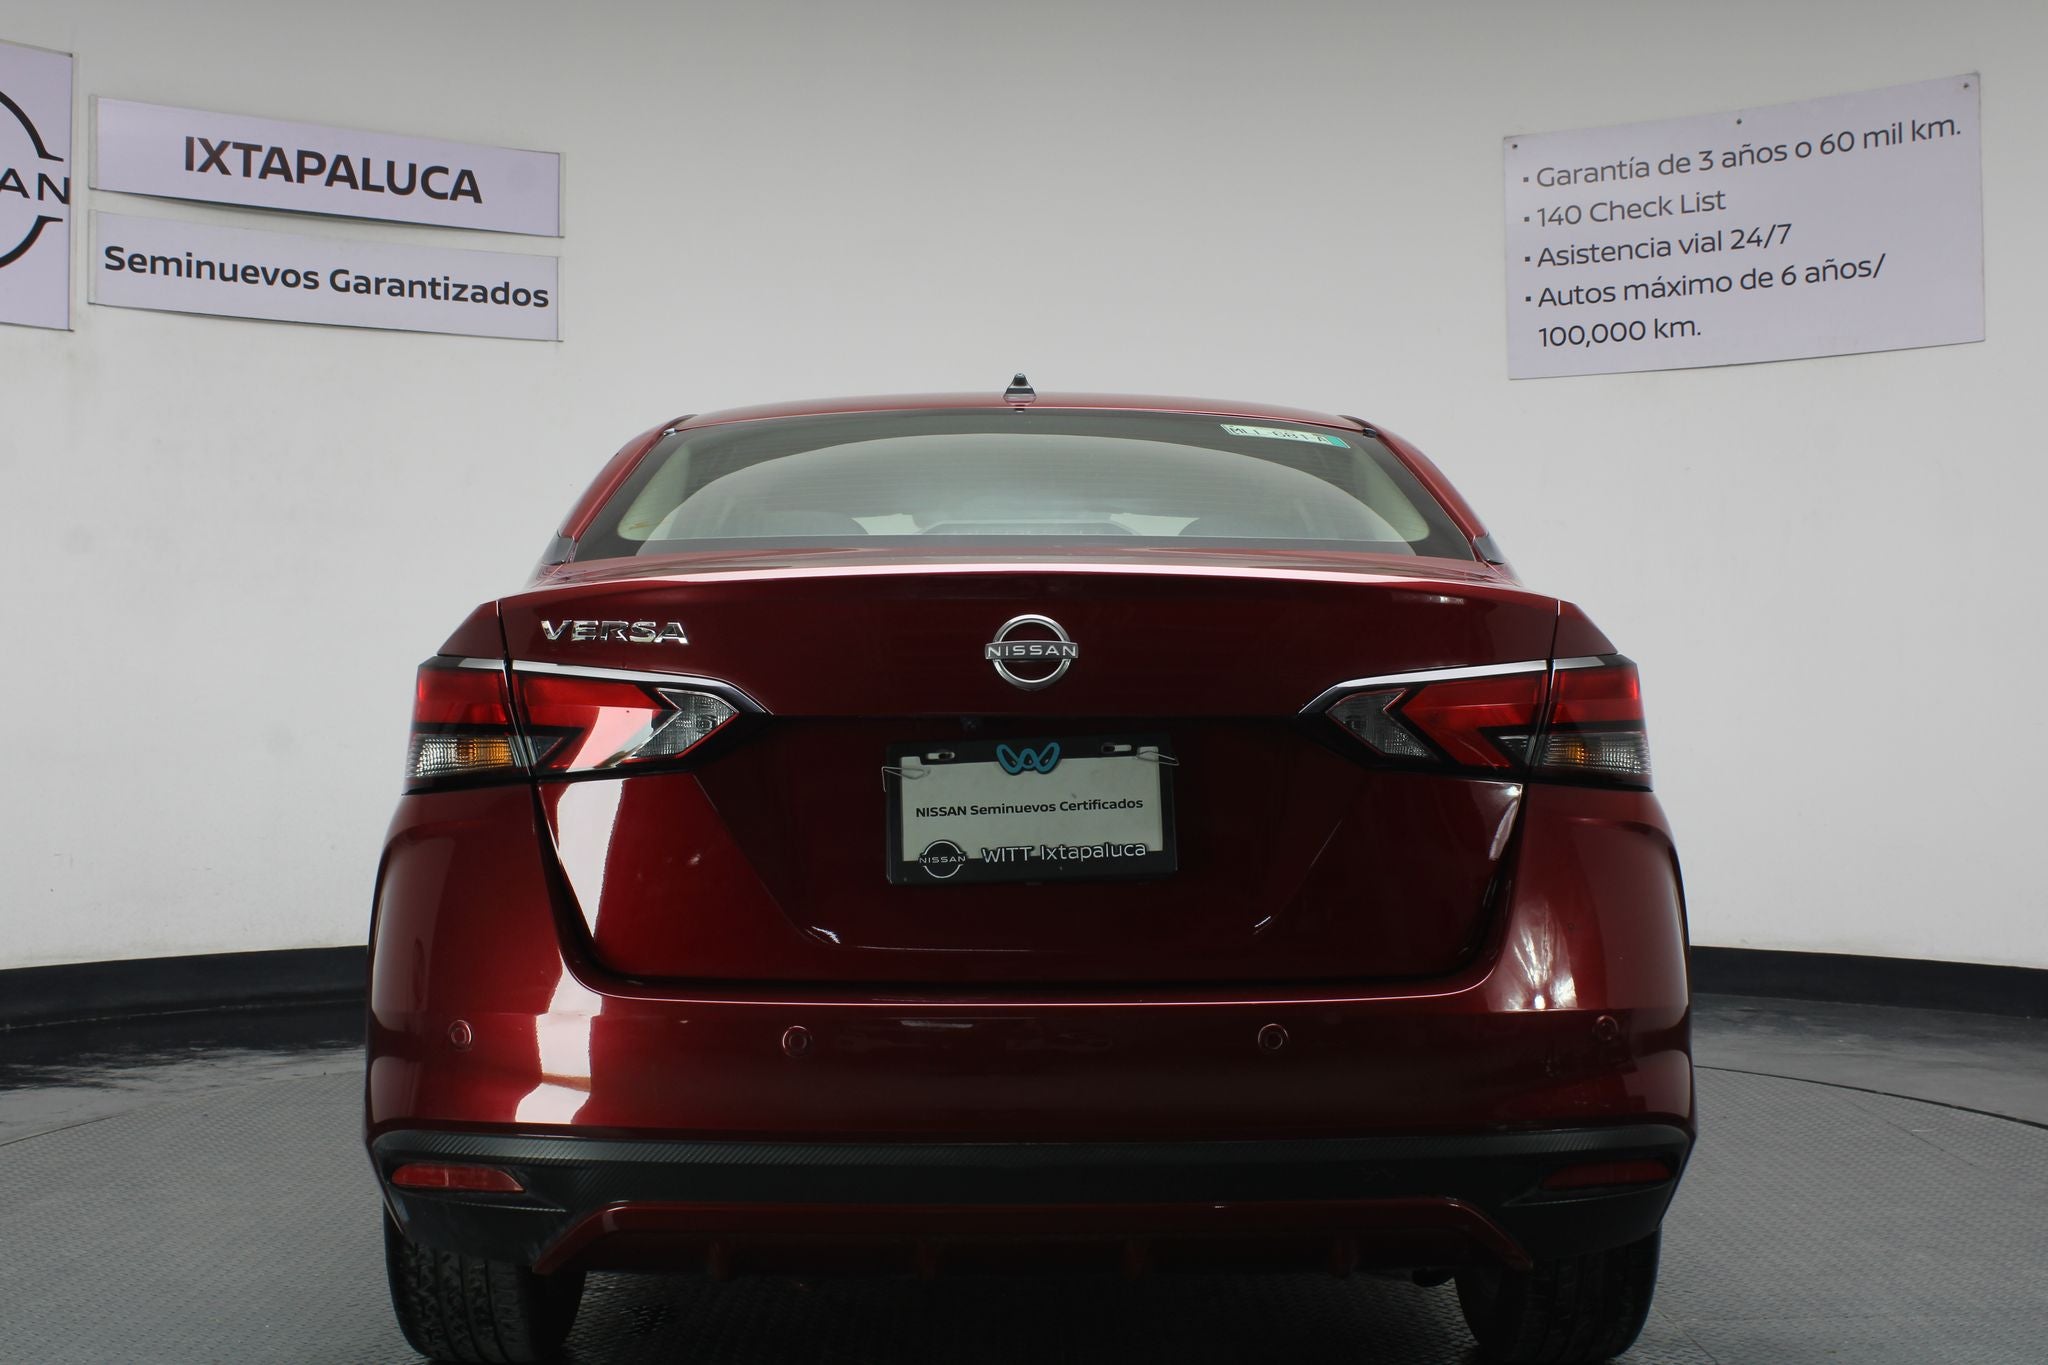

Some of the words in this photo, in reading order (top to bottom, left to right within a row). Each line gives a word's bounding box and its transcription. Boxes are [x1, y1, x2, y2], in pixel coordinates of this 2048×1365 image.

[1537, 156, 1650, 187] Garantía
[1658, 151, 1691, 175] de
[1699, 150, 1713, 171] 3
[1721, 141, 1787, 168] años
[1794, 142, 1812, 158] o
[1819, 131, 1855, 156] 60
[1863, 123, 1902, 149] mil
[1911, 117, 1961, 142] km.
[185, 136, 482, 204] IXTAPALUCA
[1538, 204, 1582, 227] 140
[1590, 196, 1672, 223] Check
[1681, 190, 1726, 213] List
[1538, 236, 1672, 267] Asistencia
[1678, 231, 1723, 254] vial
[1731, 222, 1792, 250] 24/7
[105, 246, 319, 290] Seminuevos
[329, 268, 549, 308] Garantizados
[1538, 283, 1616, 307] Autos
[1623, 275, 1732, 300] máximo
[1740, 268, 1773, 290] de
[1781, 265, 1797, 286] 6
[1805, 253, 1886, 283] años/
[1539, 321, 1646, 349] 100,000
[1654, 315, 1701, 339] km.
[541, 620, 688, 645] VERSA
[987, 644, 1078, 657] NISSAN
[916, 806, 967, 817] NISSAN
[970, 801, 1056, 815] Seminuevos
[1060, 798, 1143, 812] Certificados
[919, 855, 966, 863] NISSAN
[981, 846, 1032, 862] WITT
[1041, 843, 1146, 861] Ixtapaluca
